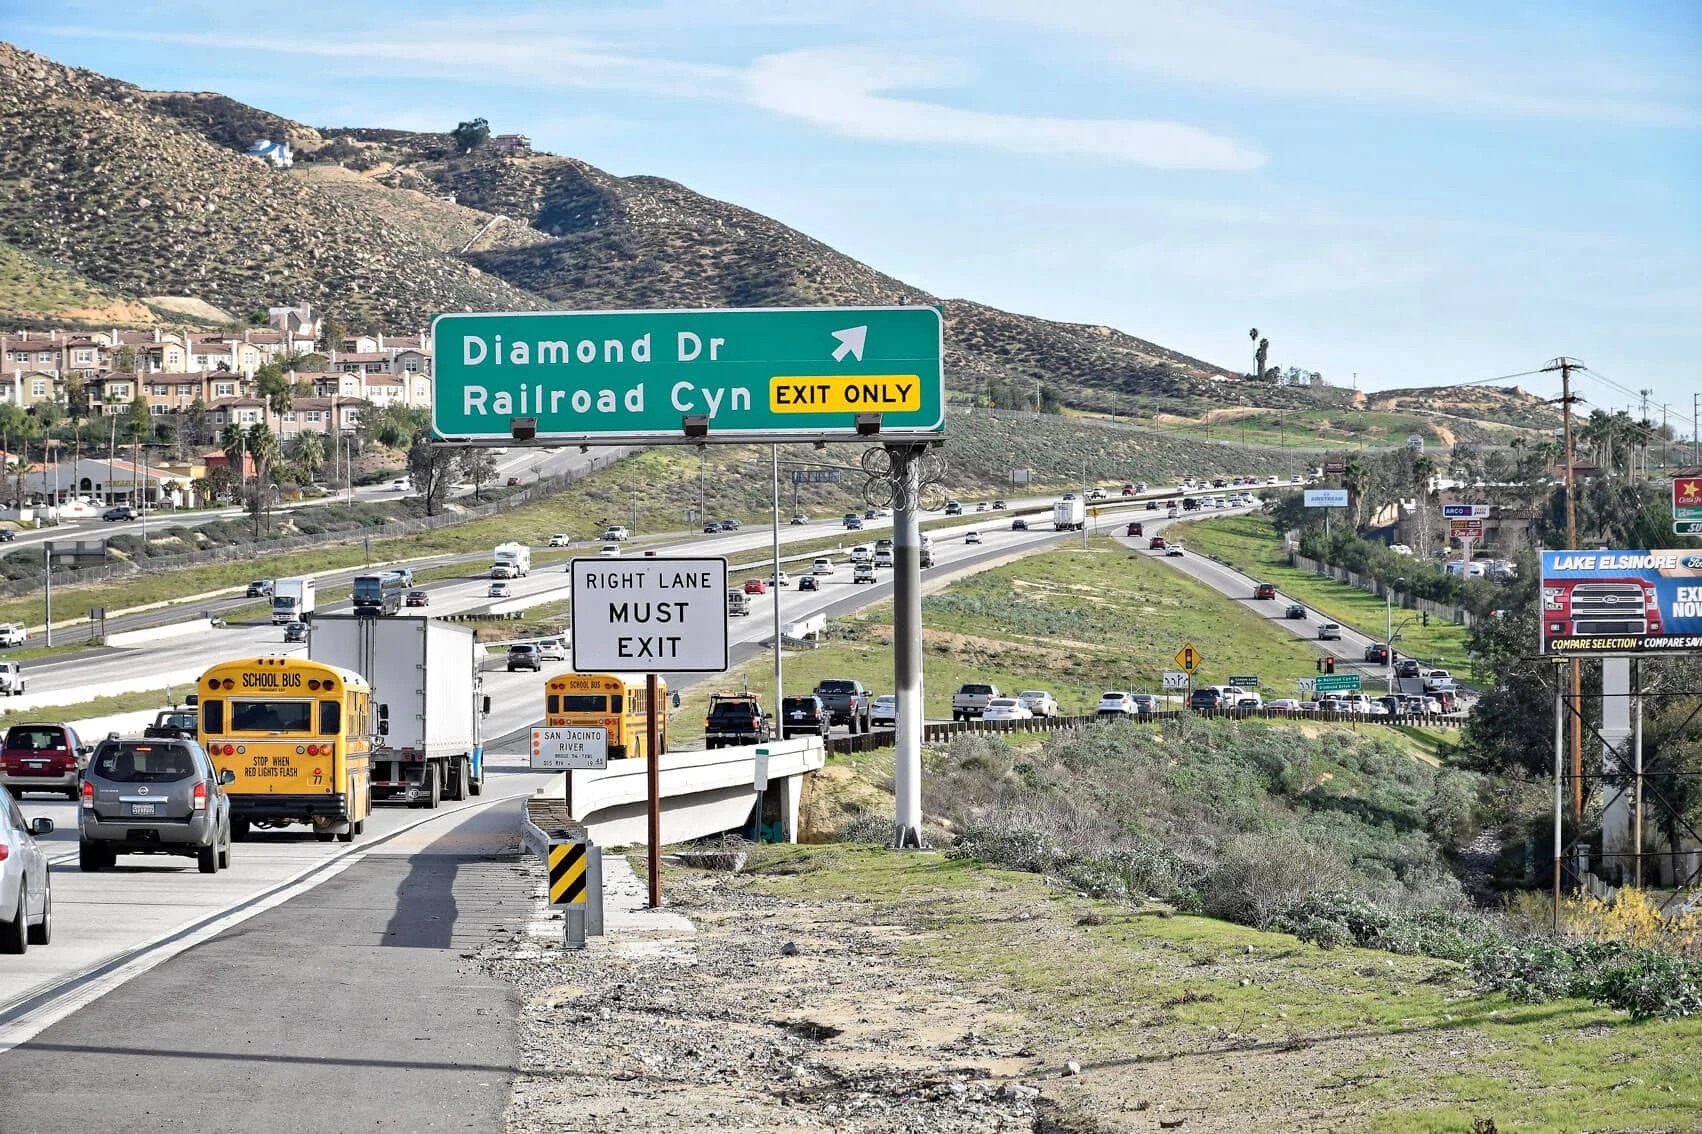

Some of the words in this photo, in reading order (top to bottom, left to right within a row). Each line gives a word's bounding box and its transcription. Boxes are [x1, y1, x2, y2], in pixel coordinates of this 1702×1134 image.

[463, 333, 652, 366] Diamond
[676, 331, 725, 362] Dr
[463, 381, 645, 416] Railroad
[670, 381, 751, 418] Cyn
[776, 385, 829, 404] EXIT
[844, 383, 913, 403] ONLY
[1552, 556, 1597, 570] LAKE
[1599, 555, 1677, 570] ELSINORE
[586, 573, 646, 589] RIGHT
[659, 572, 712, 588] LANE
[609, 602, 689, 623] MUST
[618, 637, 681, 658] EXIT
[1551, 640, 1591, 649] COMPARE
[1591, 638, 1638, 649] SELECTION
[1643, 638, 1686, 648] COMPARE
[242, 672, 279, 688] SCHOOL
[282, 672, 301, 688] BUS
[569, 680, 589, 689] SCHOOL
[590, 680, 601, 689] BUS
[544, 731, 561, 740] SAN
[566, 730, 601, 741] JACINTO
[559, 743, 584, 752] RIVER
[253, 756, 268, 767] STOP
[272, 756, 290, 767] WHEN
[244, 767, 256, 777] RED
[257, 767, 279, 777] LIGHTS
[280, 767, 298, 777] FLASH
[312, 775, 323, 785] 77
